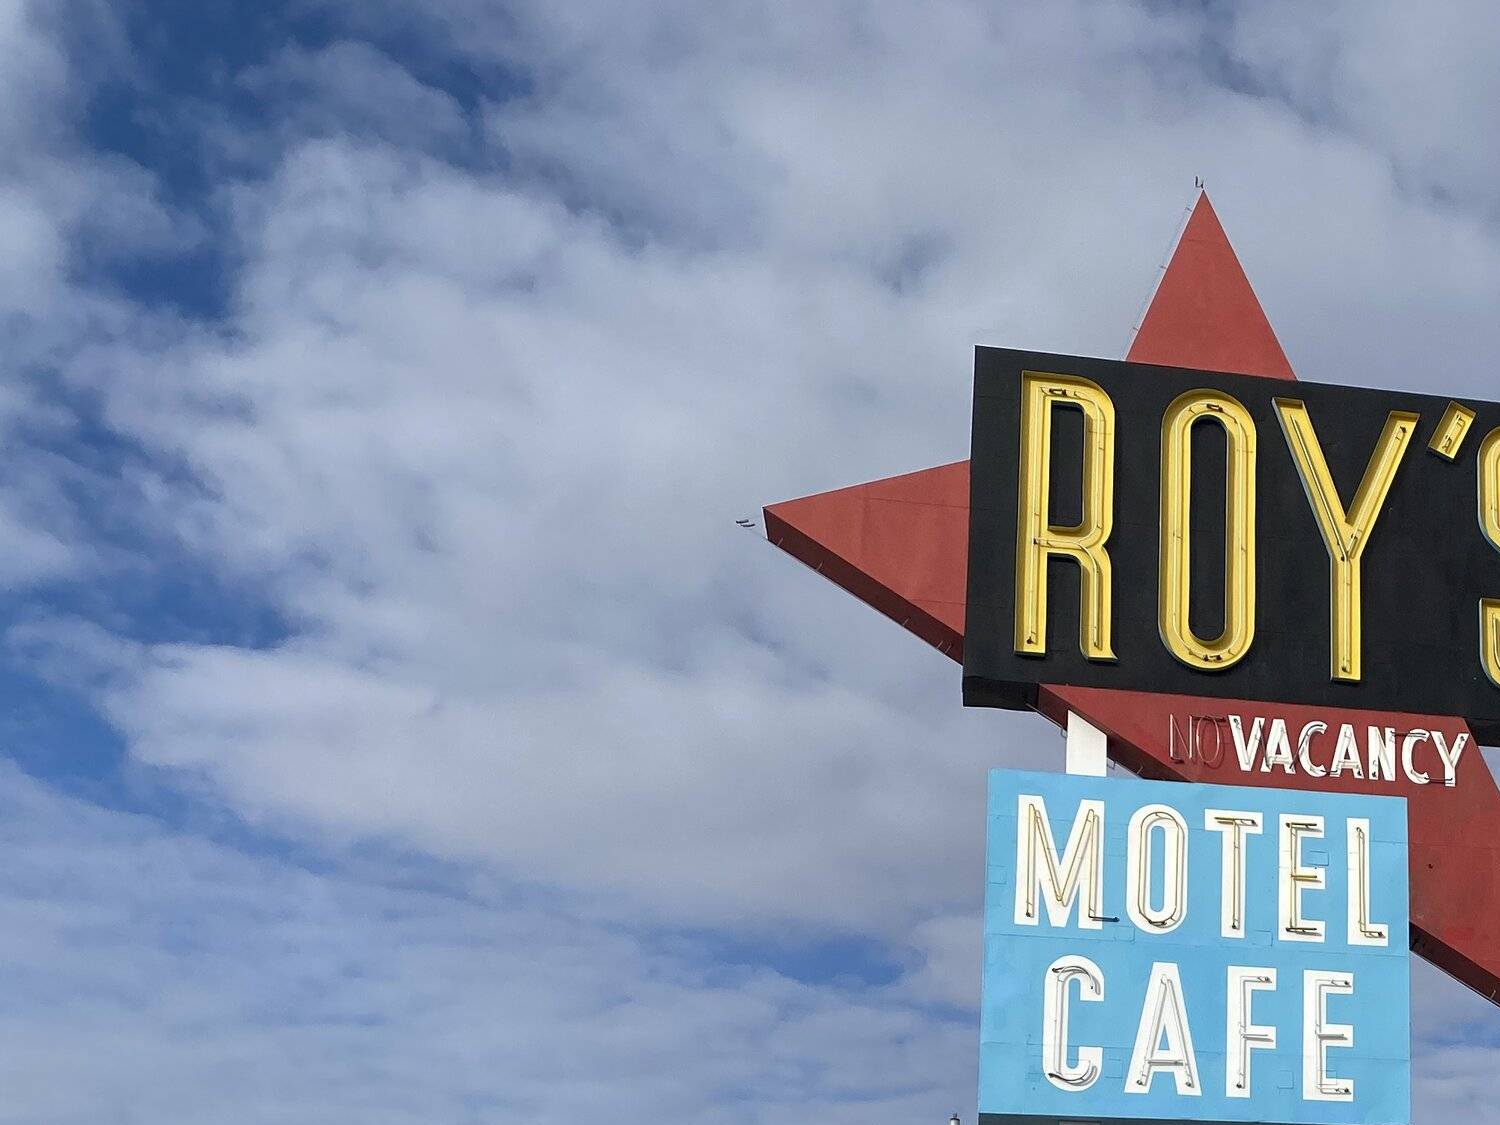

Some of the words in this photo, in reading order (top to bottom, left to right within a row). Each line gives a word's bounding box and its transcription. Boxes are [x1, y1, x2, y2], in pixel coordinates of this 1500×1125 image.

[1168, 712, 1224, 766] NO
[1227, 714, 1470, 788] VACANCY
[1013, 793, 1390, 947] MOTEL
[1042, 954, 1355, 1102] CAFE
